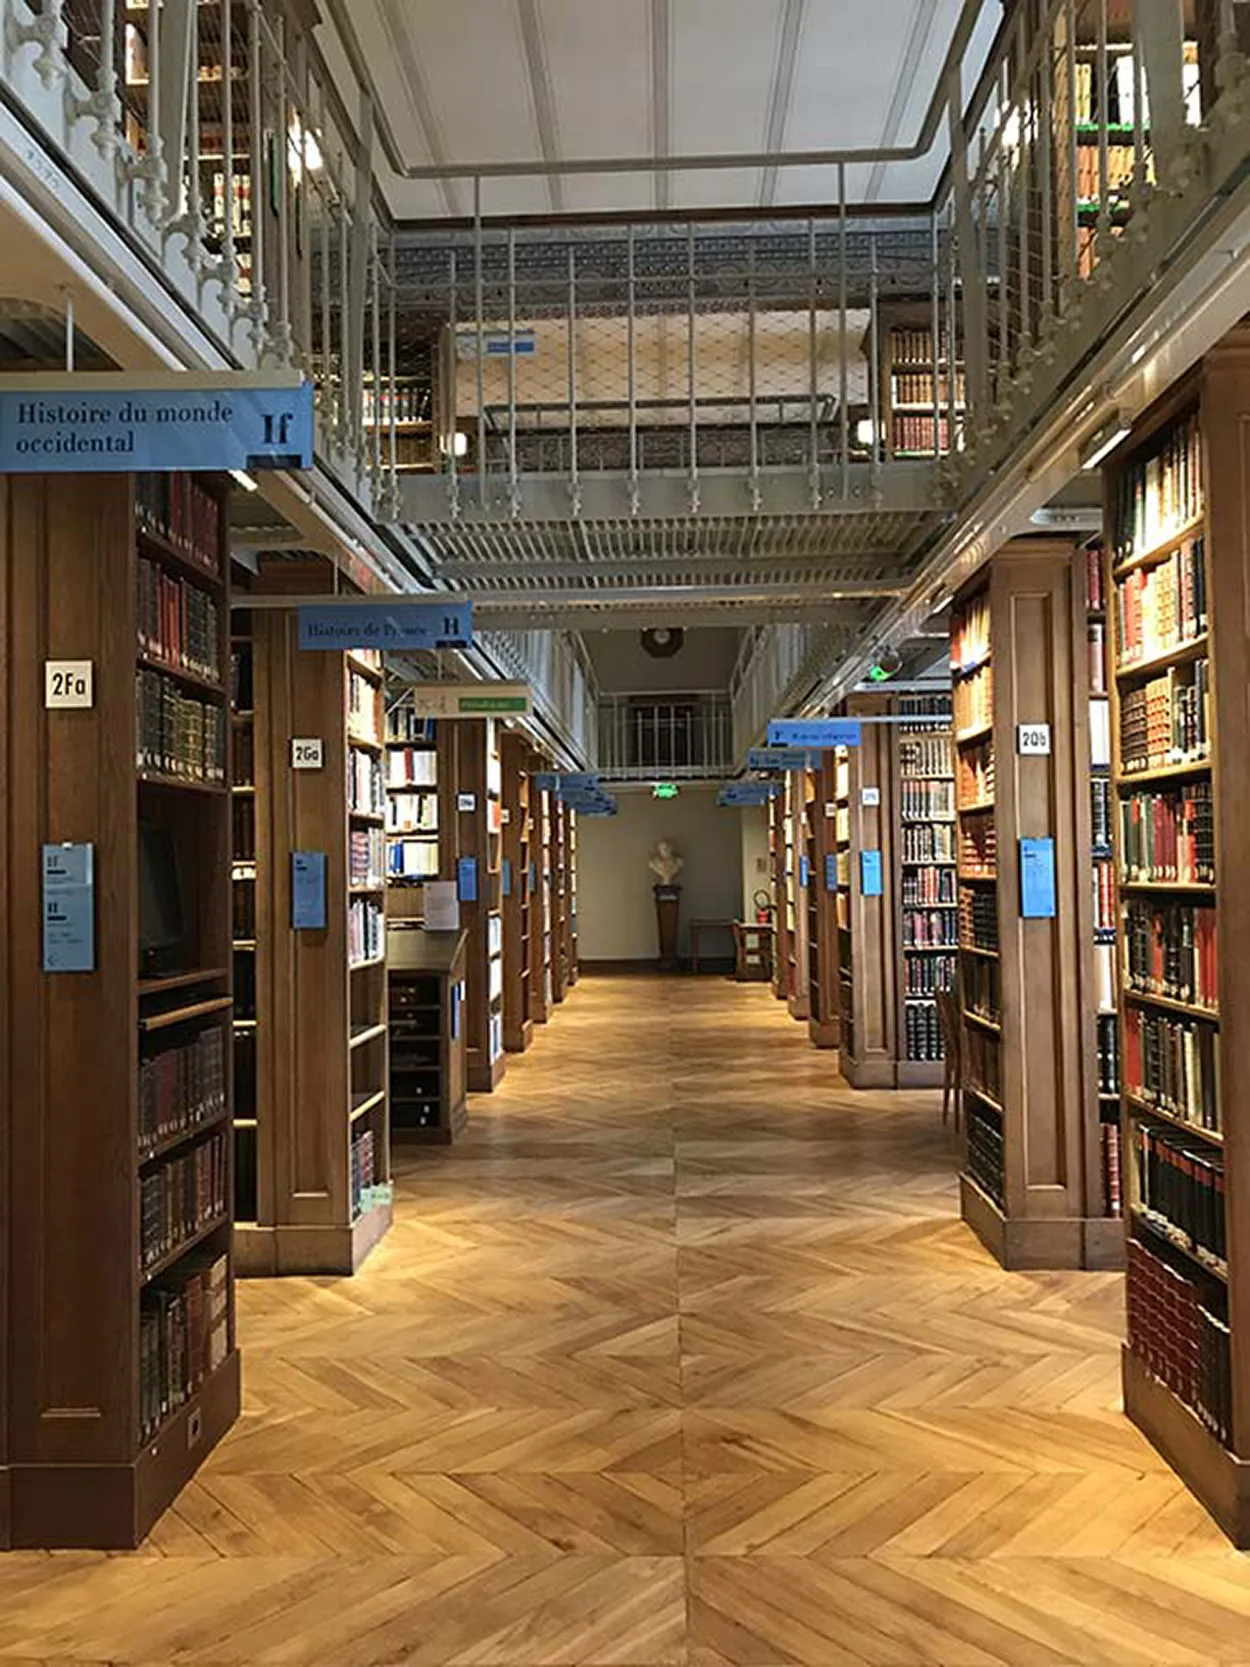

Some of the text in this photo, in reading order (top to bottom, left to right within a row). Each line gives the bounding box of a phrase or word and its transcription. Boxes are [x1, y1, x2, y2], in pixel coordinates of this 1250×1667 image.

[18, 400, 233, 424] Histoire du monde
[261, 414, 294, 444] If
[16, 430, 135, 454] occidental
[444, 617, 460, 635] H
[52, 672, 86, 696] 2Fa
[295, 746, 319, 761] 2Ga
